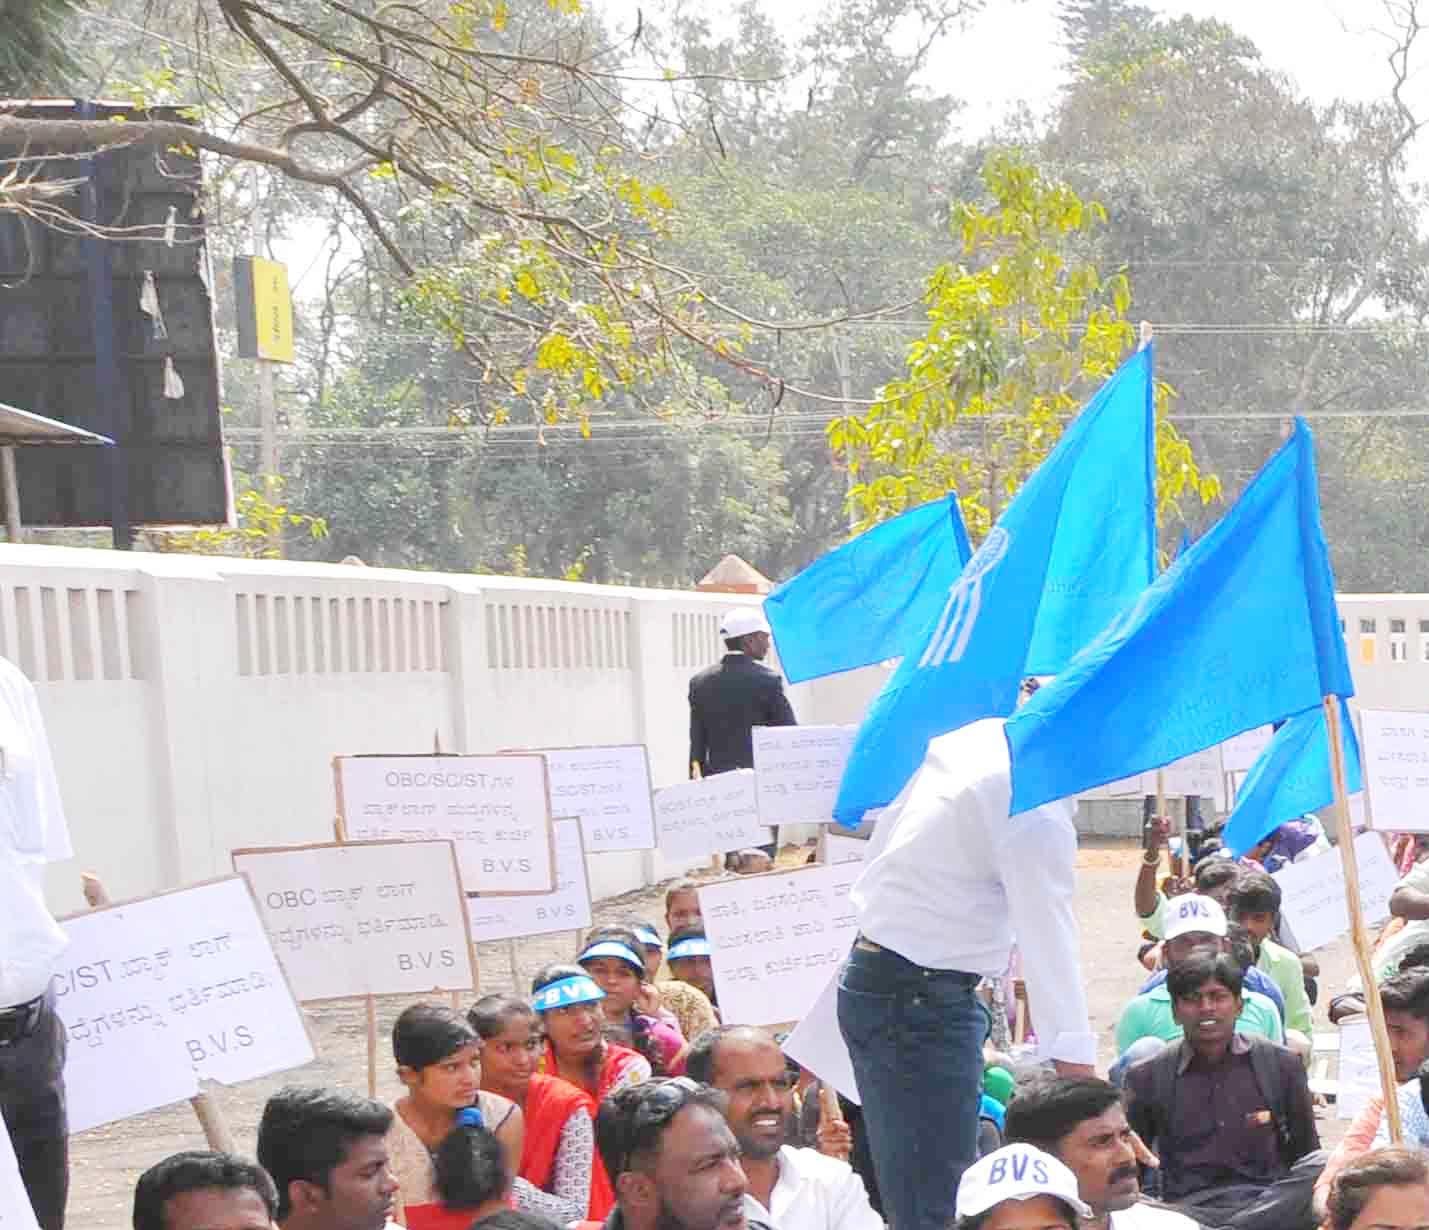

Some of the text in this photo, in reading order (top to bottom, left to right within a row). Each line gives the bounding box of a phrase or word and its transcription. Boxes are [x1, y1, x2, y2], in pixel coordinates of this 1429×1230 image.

[266, 888, 317, 910] OBC
[397, 949, 456, 971] B.V.S
[185, 1024, 254, 1062] B.V.S
[989, 1153, 1049, 1184] BVS
